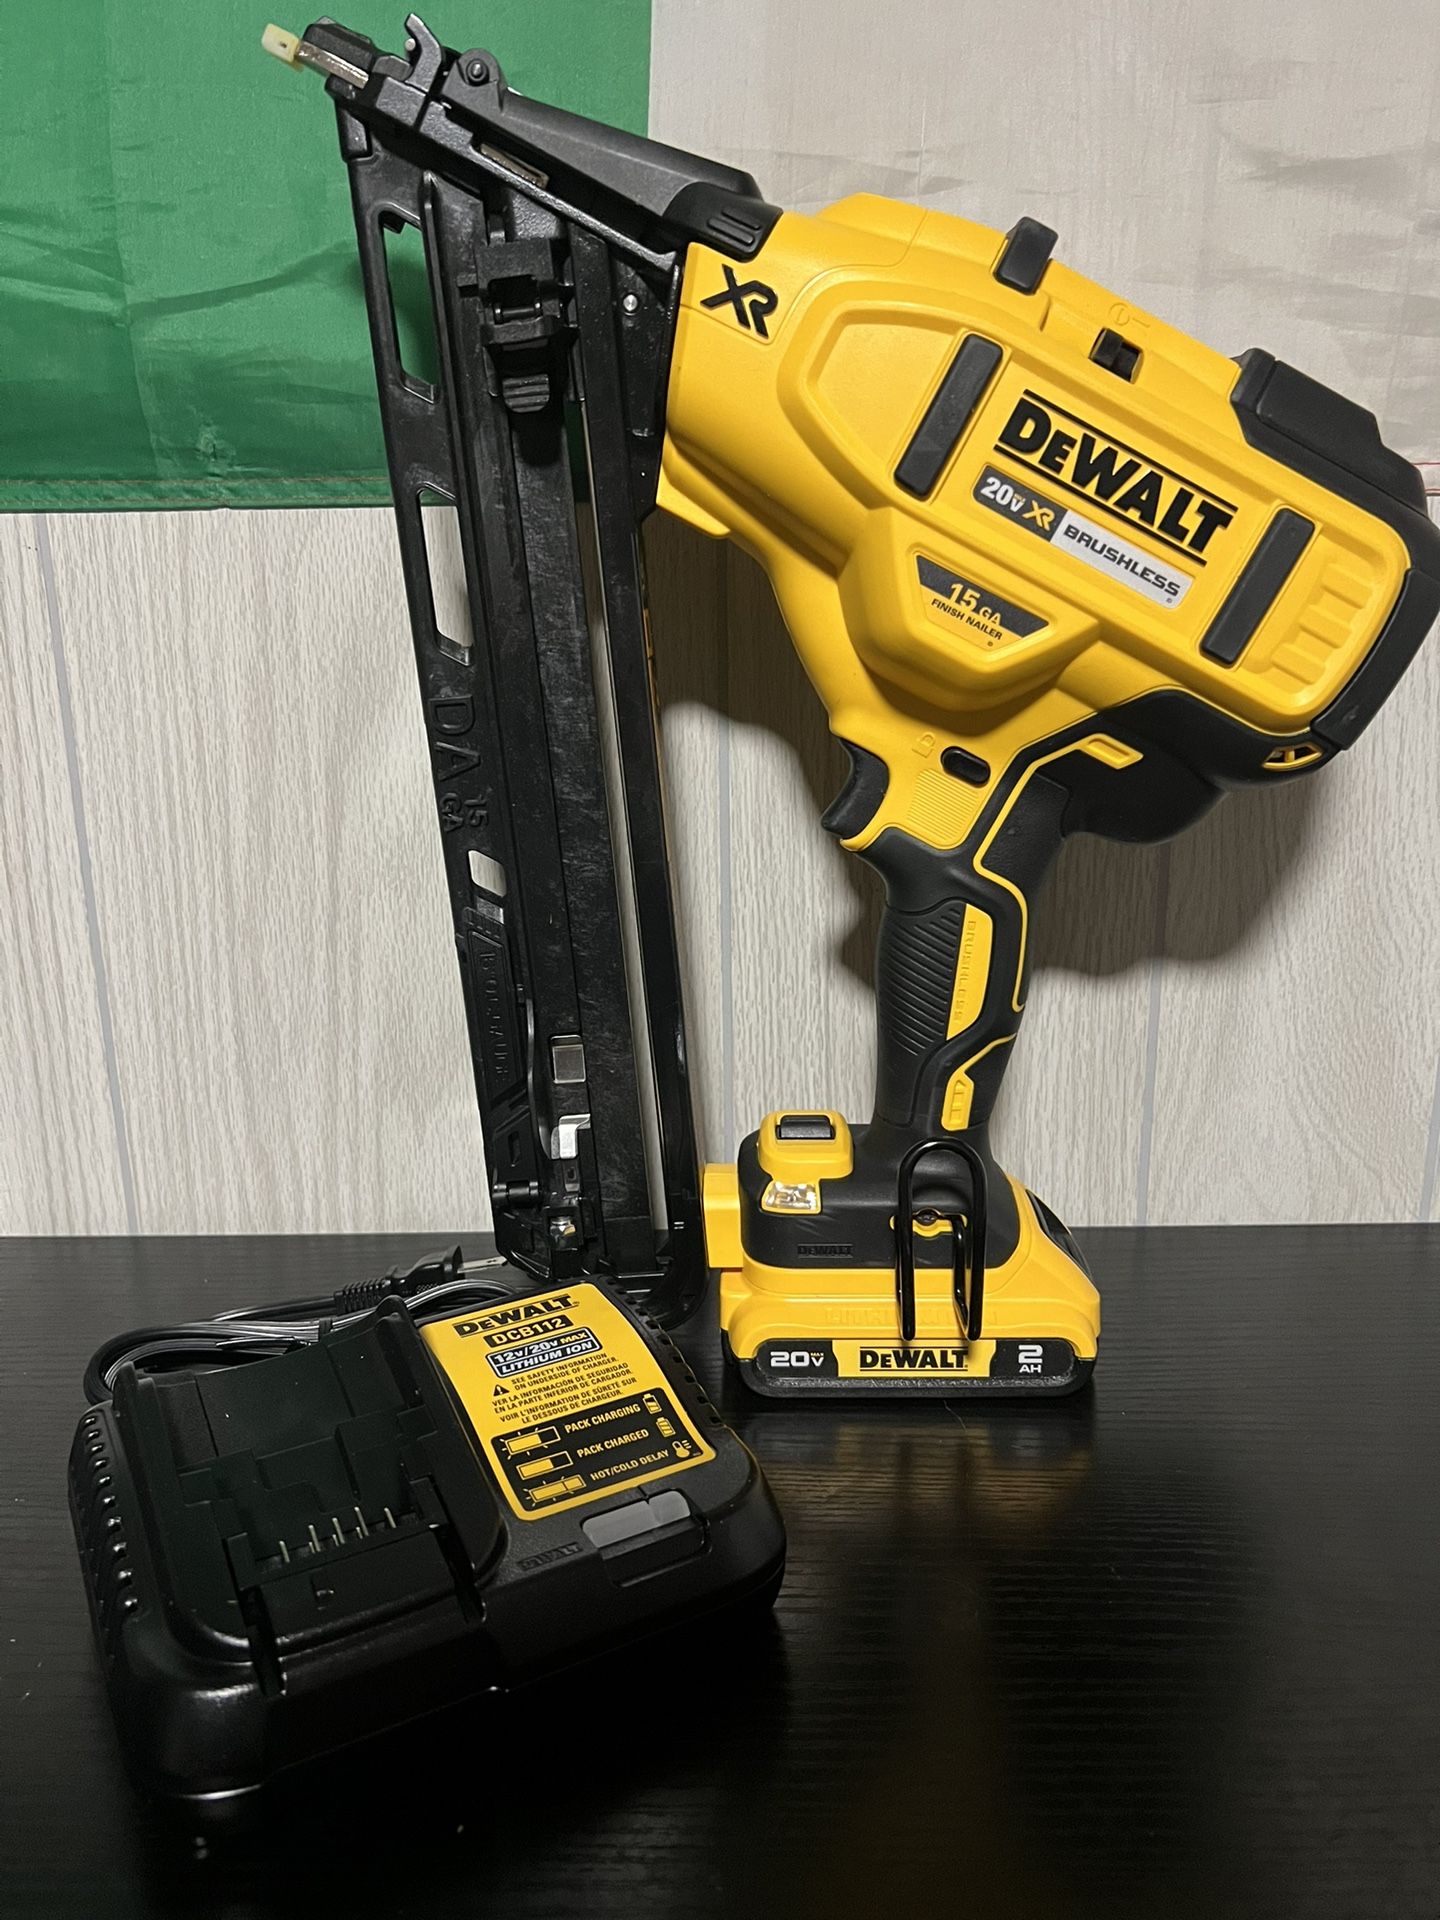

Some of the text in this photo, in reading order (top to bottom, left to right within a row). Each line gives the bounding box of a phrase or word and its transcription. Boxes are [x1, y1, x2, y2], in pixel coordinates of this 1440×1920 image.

[700, 263, 779, 340] XR
[1022, 499, 1056, 532] XR
[1063, 523, 1181, 598] BRUSHLESS
[931, 598, 1003, 641] FINISH NAILER
[950, 583, 1003, 626] 15 GA
[491, 1317, 566, 1345] DCB112
[560, 1332, 589, 1345] MAX
[501, 1341, 593, 1374] LITHIUM ION
[511, 1352, 607, 1385] SEE SAFETY INFORMATION
[1018, 1344, 1043, 1364] 2
[1019, 1364, 1042, 1374] AH
[492, 1398, 508, 1407] VER
[575, 1374, 586, 1383] DE
[586, 1362, 629, 1379] SEGURIDAD
[514, 1383, 527, 1391] ON
[527, 1370, 571, 1387] UNDERSIDE
[571, 1366, 582, 1374] OF
[494, 1406, 506, 1414] EN
[507, 1402, 518, 1410] LA
[518, 1395, 543, 1407] PARTE
[544, 1383, 579, 1399] INFERIOR
[580, 1380, 591, 1389] DE
[500, 1412, 519, 1422] VOIR
[520, 1394, 580, 1416] L'INFORMATION
[581, 1390, 592, 1398] DE
[621, 1376, 637, 1386] SUR
[522, 1416, 531, 1424] LE
[532, 1405, 568, 1421] DESSOUS
[569, 1402, 581, 1410] DE
[564, 1403, 641, 1434] PACK CHARGING
[577, 1428, 650, 1458] PACK CHARGED
[590, 1449, 670, 1481] HOT/COLD DELAY
